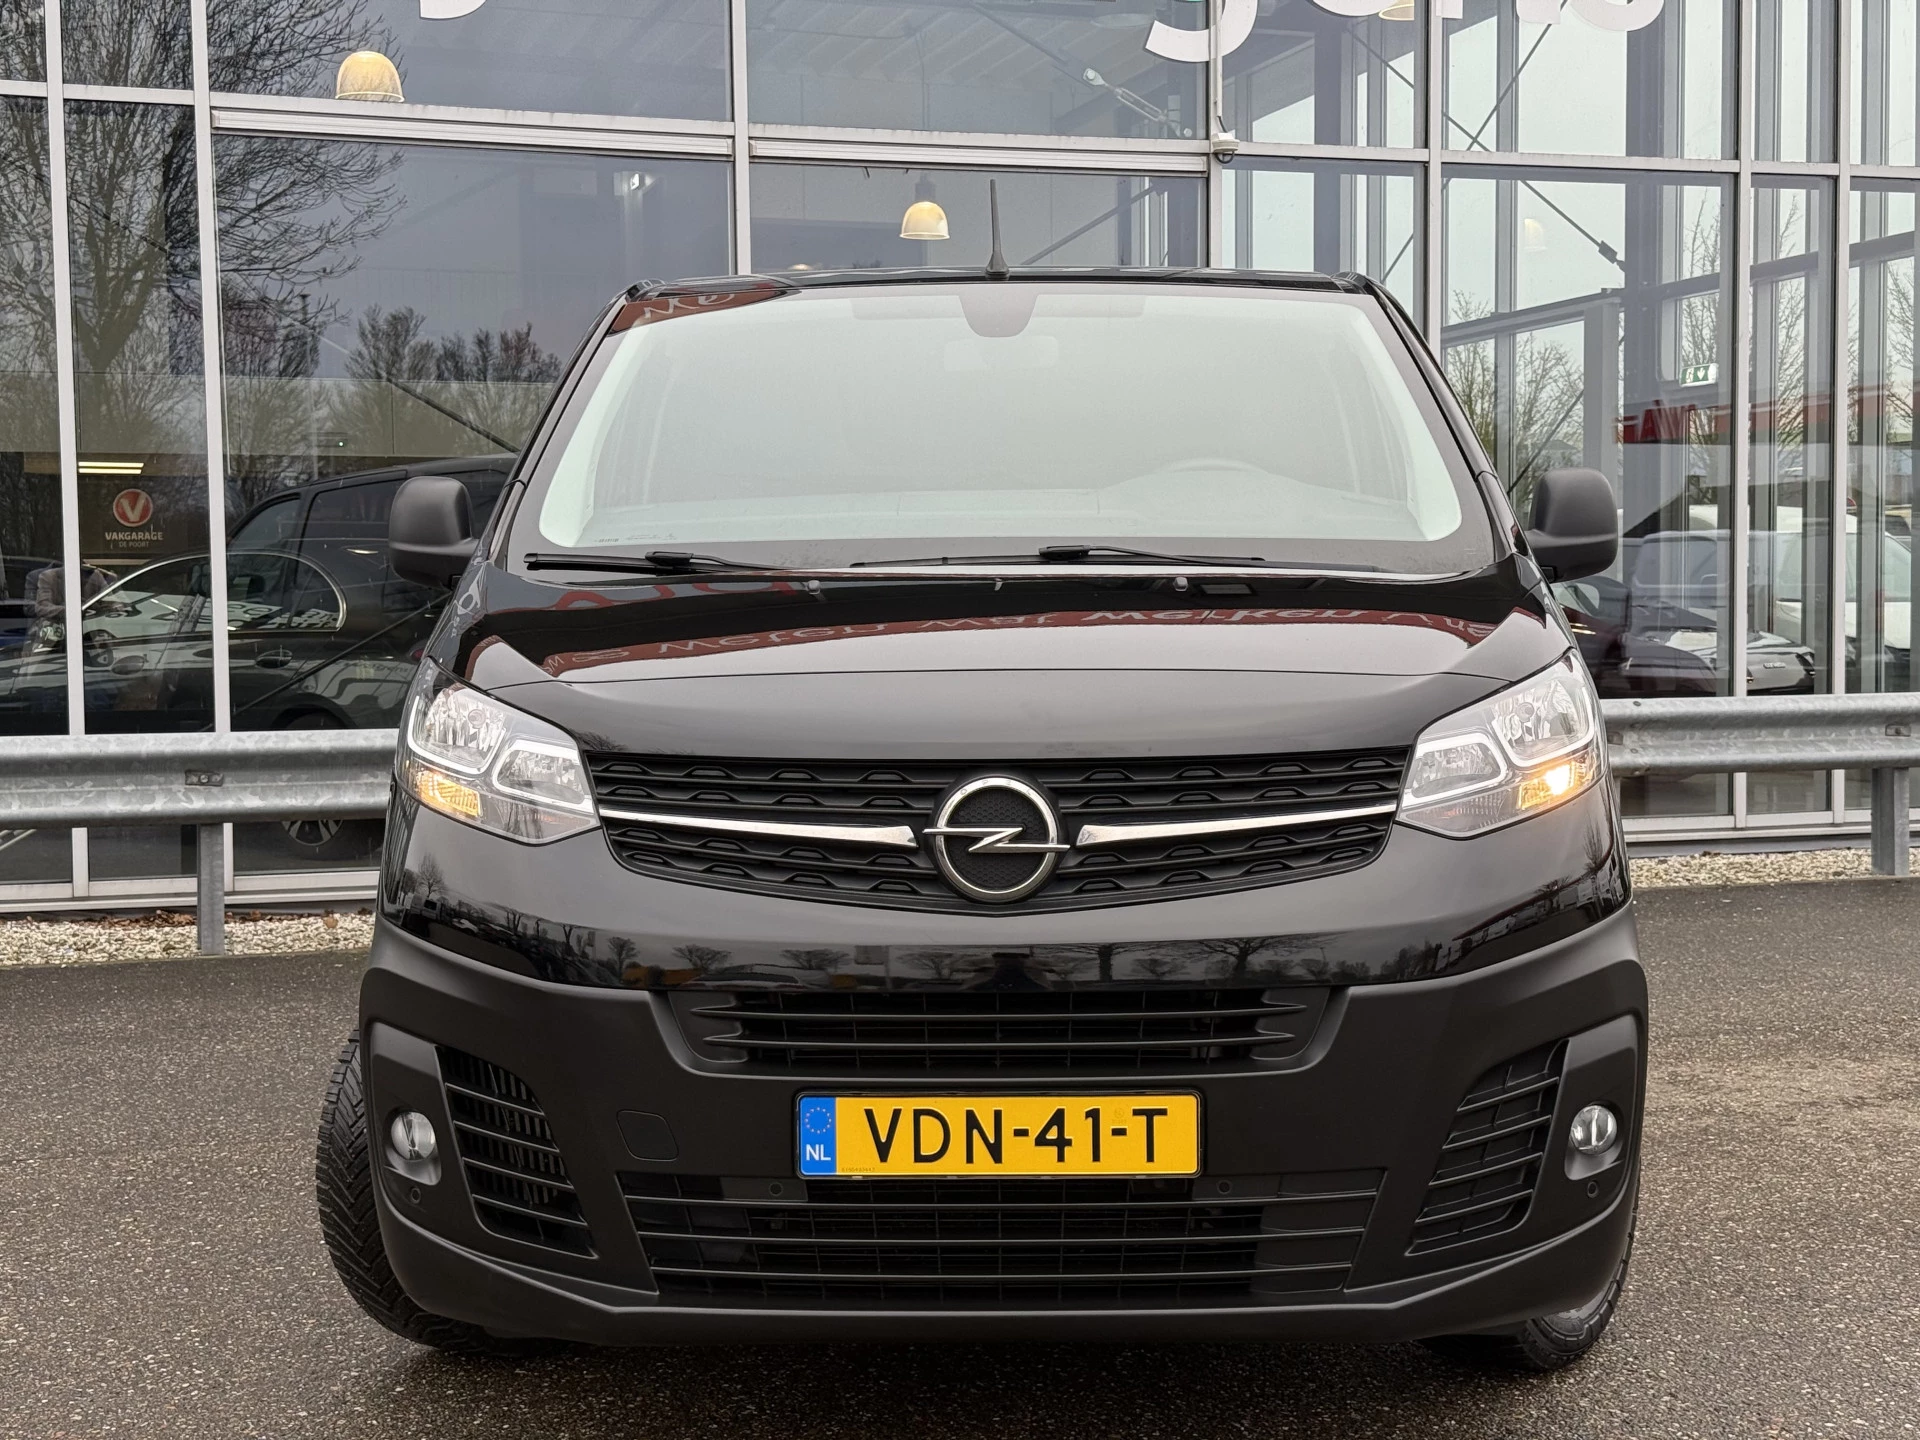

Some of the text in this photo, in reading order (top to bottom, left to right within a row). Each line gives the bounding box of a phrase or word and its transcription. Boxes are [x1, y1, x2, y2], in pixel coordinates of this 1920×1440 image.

[105, 531, 164, 540] VAKGARAGE
[864, 1107, 1168, 1165] VDN-41-T
[805, 1144, 831, 1162] NL
